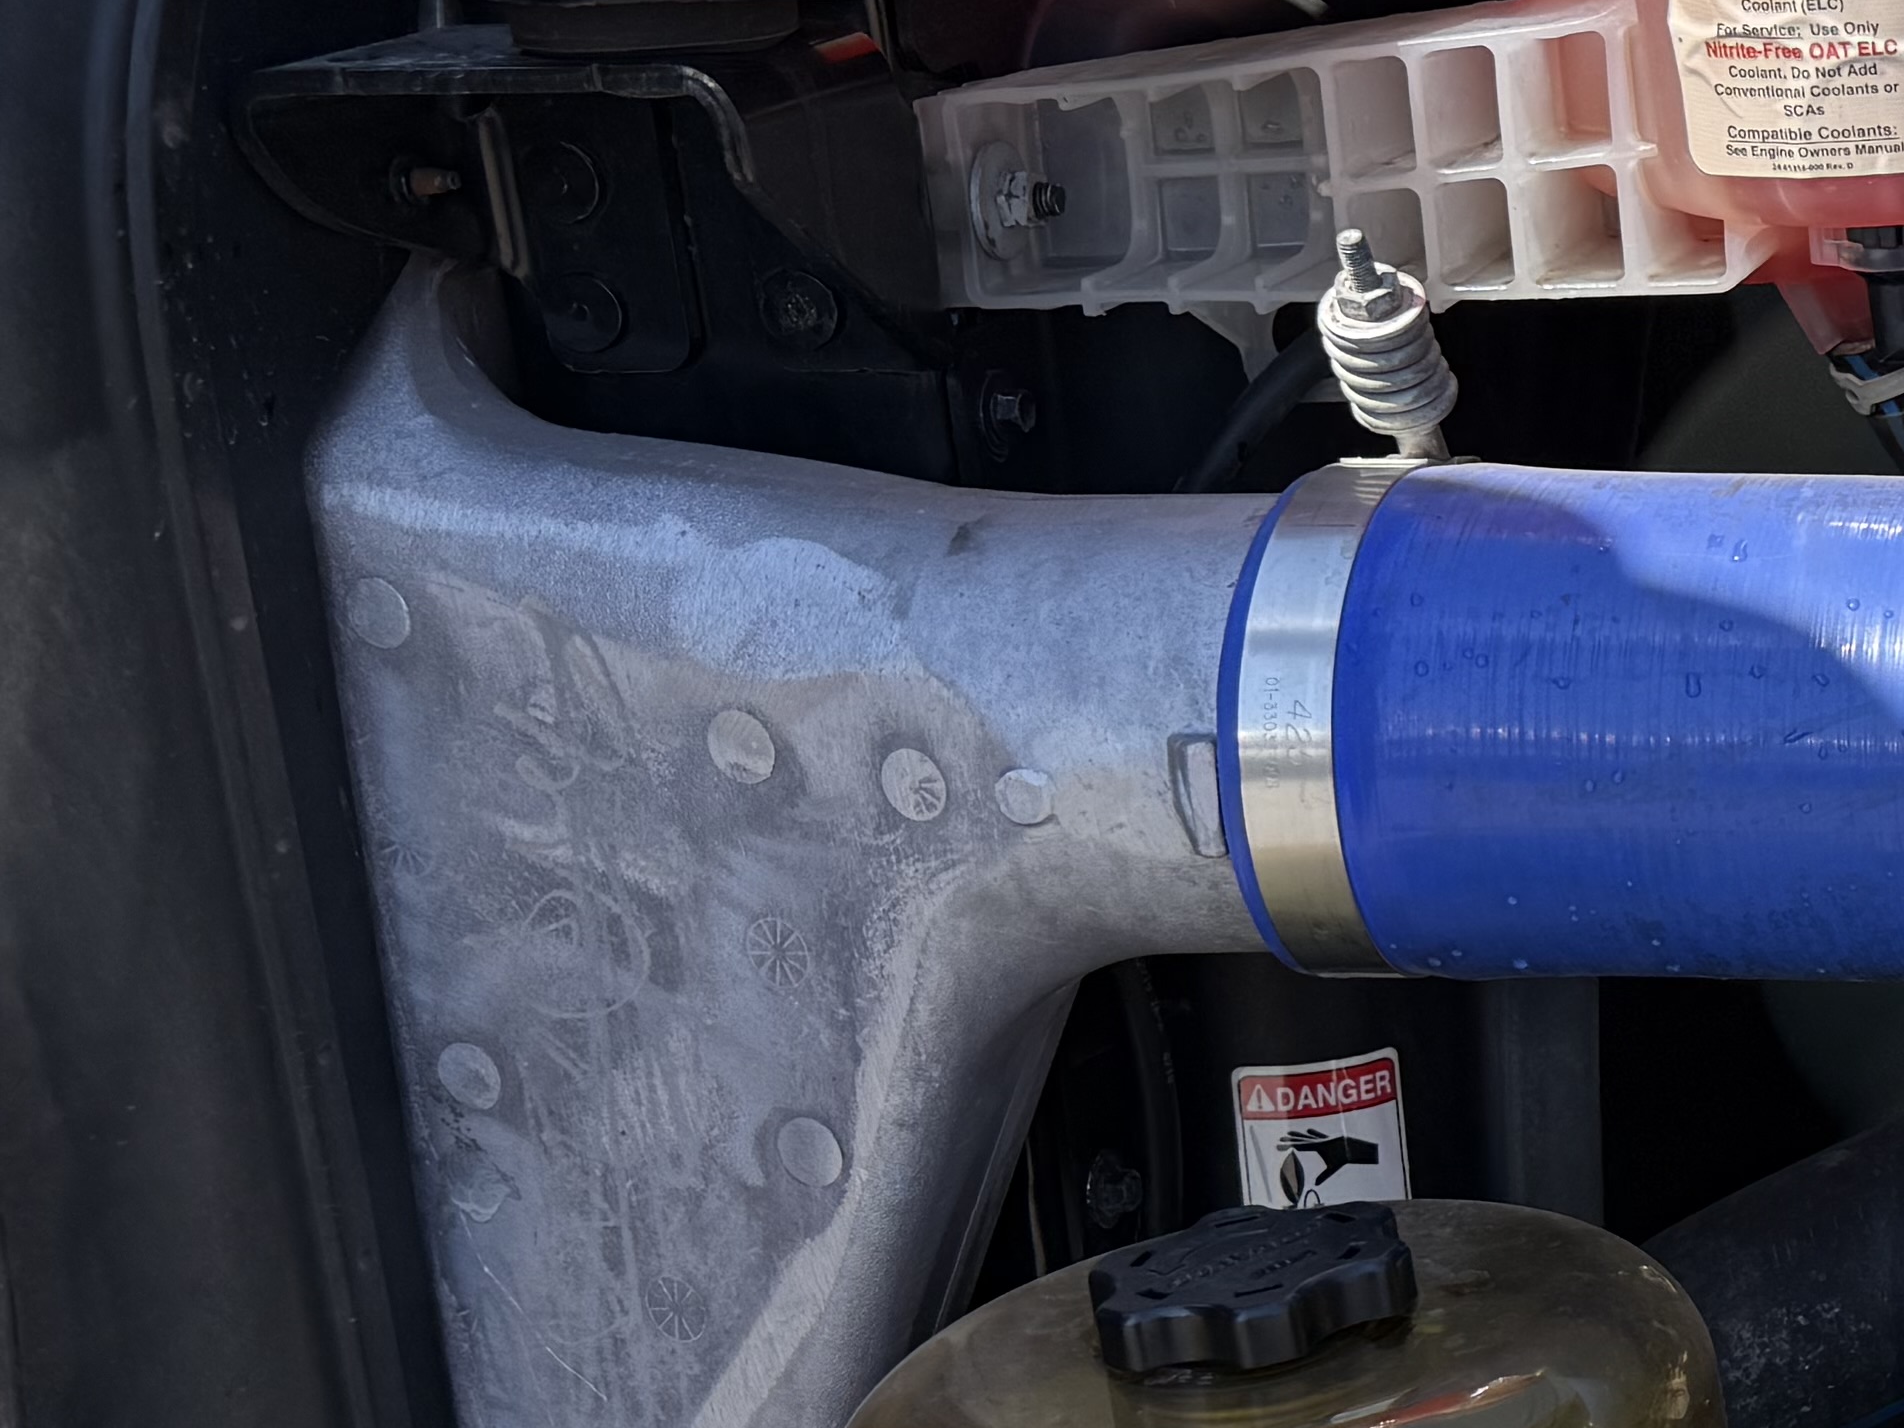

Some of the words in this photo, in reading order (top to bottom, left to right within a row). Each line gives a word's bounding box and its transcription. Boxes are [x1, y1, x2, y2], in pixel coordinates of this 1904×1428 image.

[1716, 23, 1738, 38] For
[1742, 22, 1802, 39] Service:
[1810, 23, 1839, 37] Use
[1843, 20, 1880, 38] Only
[1705, 42, 1803, 60] Nitrite-Free
[1809, 42, 1851, 60] OAT
[1857, 39, 1898, 57] ELC
[1791, 66, 1812, 80] Do
[1815, 66, 1843, 80] Not
[1847, 63, 1878, 77] Add
[1714, 83, 1806, 100] Conventional
[1810, 83, 1879, 98] Coolants
[1883, 82, 1900, 95] or
[1783, 104, 1825, 117] SCAs
[1727, 125, 1812, 143] Compatible
[1818, 124, 1898, 140] Coolants:
[1725, 144, 1748, 158] See
[1751, 145, 1795, 160] Engine
[1798, 145, 1851, 160] Owners
[1855, 141, 1904, 157] Manual
[1276, 1070, 1392, 1112] DANGER
